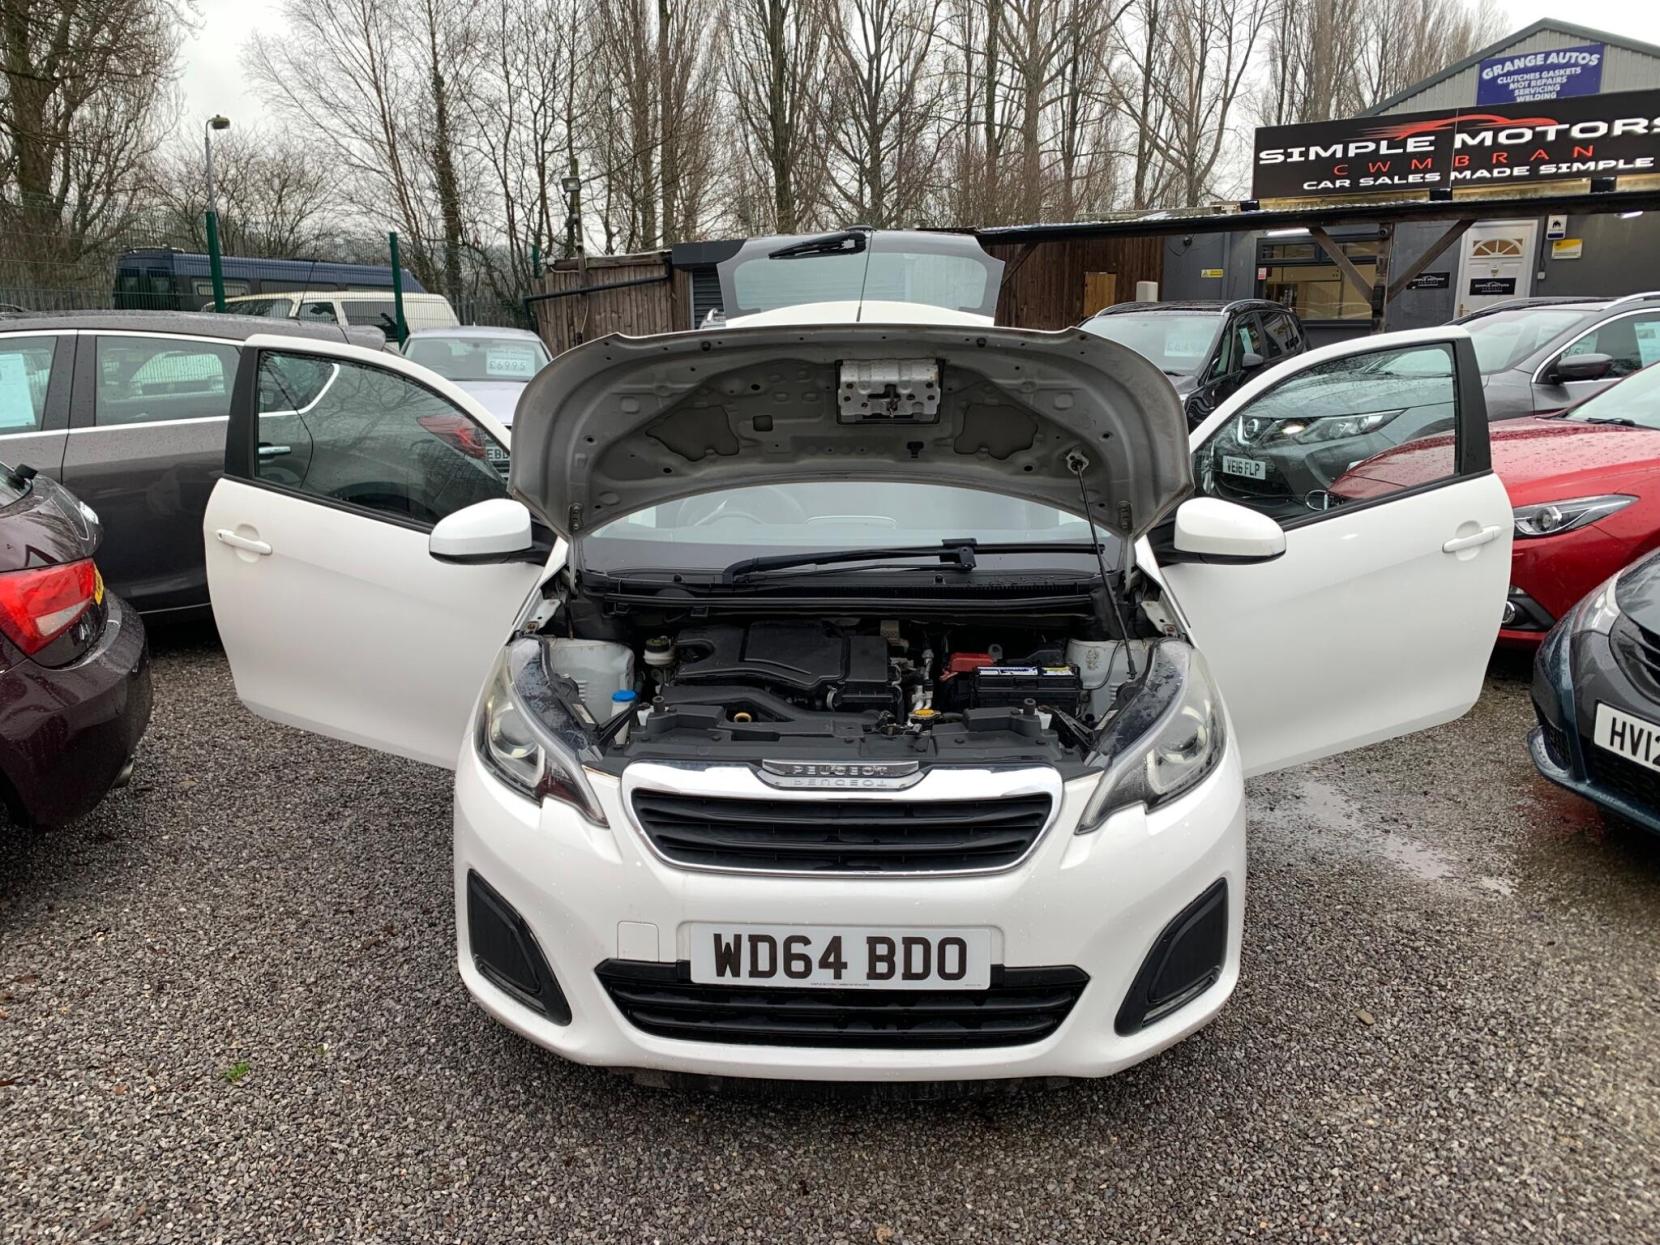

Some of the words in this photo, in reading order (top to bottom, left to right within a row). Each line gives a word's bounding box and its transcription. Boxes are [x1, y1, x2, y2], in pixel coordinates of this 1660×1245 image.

[1482, 53, 1545, 79] GRANGE
[1546, 51, 1601, 66] AUTOS
[1497, 72, 1540, 84] CLUTCHES
[1541, 66, 1581, 78] GASKETS
[1509, 81, 1529, 90] MOT
[1530, 76, 1567, 87] REPAIRS
[1514, 84, 1560, 96] SERVICING
[1516, 92, 1557, 102] WELDING
[1259, 136, 1435, 164] SIMPLE
[1454, 117, 1660, 149] MOTOR
[1333, 145, 1594, 176] CWMBRAN
[1303, 179, 1351, 190] CAR
[1359, 172, 1441, 187] SALES
[1450, 166, 1530, 180] MADE
[1539, 157, 1654, 175] SIMPLE
[792, 765, 888, 776] PEUGEOT
[713, 933, 848, 980] WD64
[866, 936, 967, 981] BDO
